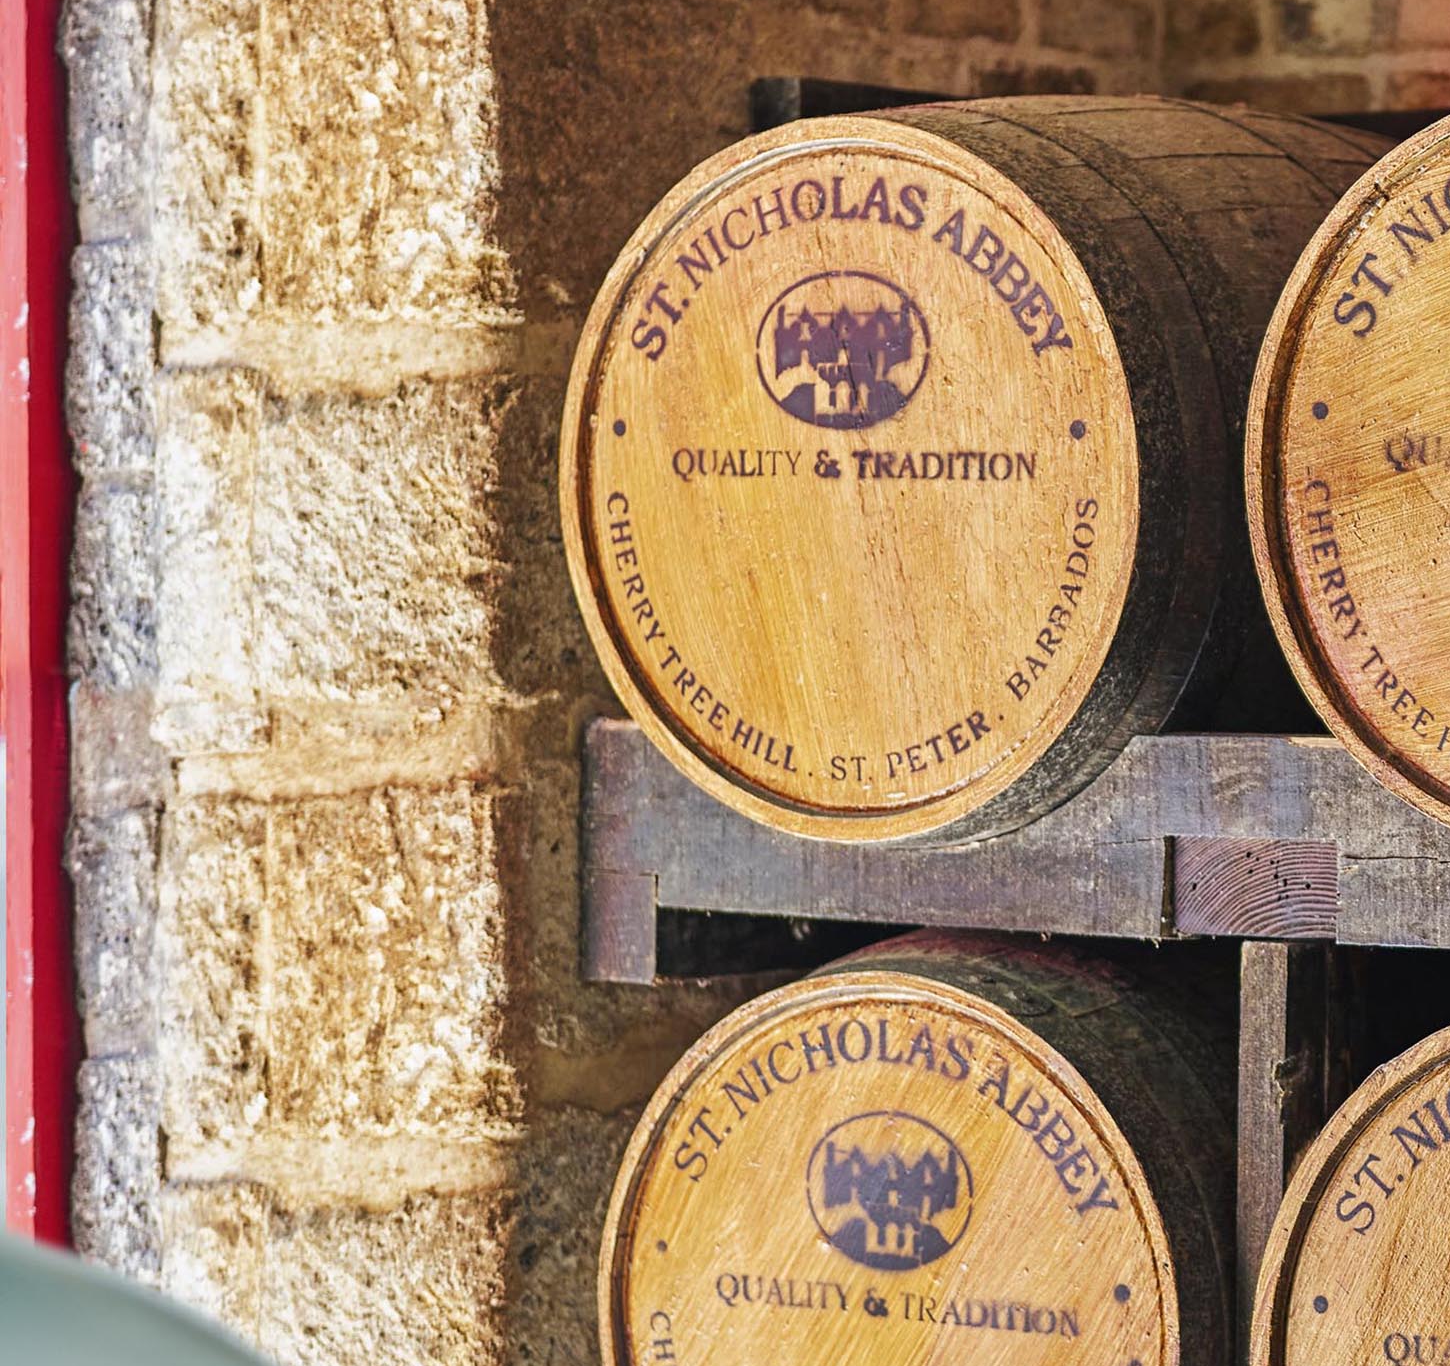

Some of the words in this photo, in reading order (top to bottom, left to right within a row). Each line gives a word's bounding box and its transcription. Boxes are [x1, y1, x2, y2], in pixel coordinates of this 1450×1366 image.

[631, 282, 689, 361] ST.
[682, 177, 928, 293] NICHOLAS
[931, 207, 1074, 357] ABBEY
[672, 448, 801, 482] QUALITY
[814, 450, 842, 479] &
[851, 448, 1037, 482] TRADITION
[606, 493, 666, 643] CHERRY
[661, 644, 728, 731] TREE
[732, 716, 798, 774] HILL
[830, 755, 873, 781] ST.
[1006, 497, 1099, 701] BARBADOS
[1305, 479, 1367, 641] CHERRY
[1360, 645, 1434, 737] TREE
[674, 1122, 726, 1183] ST.
[722, 1018, 974, 1123] NICHOLAS
[979, 1052, 1119, 1218] ABBEY
[1335, 1153, 1405, 1237] ST.
[716, 1272, 848, 1312] QUALITY
[864, 1288, 889, 1319] &
[901, 1291, 1080, 1338] TRADITION
